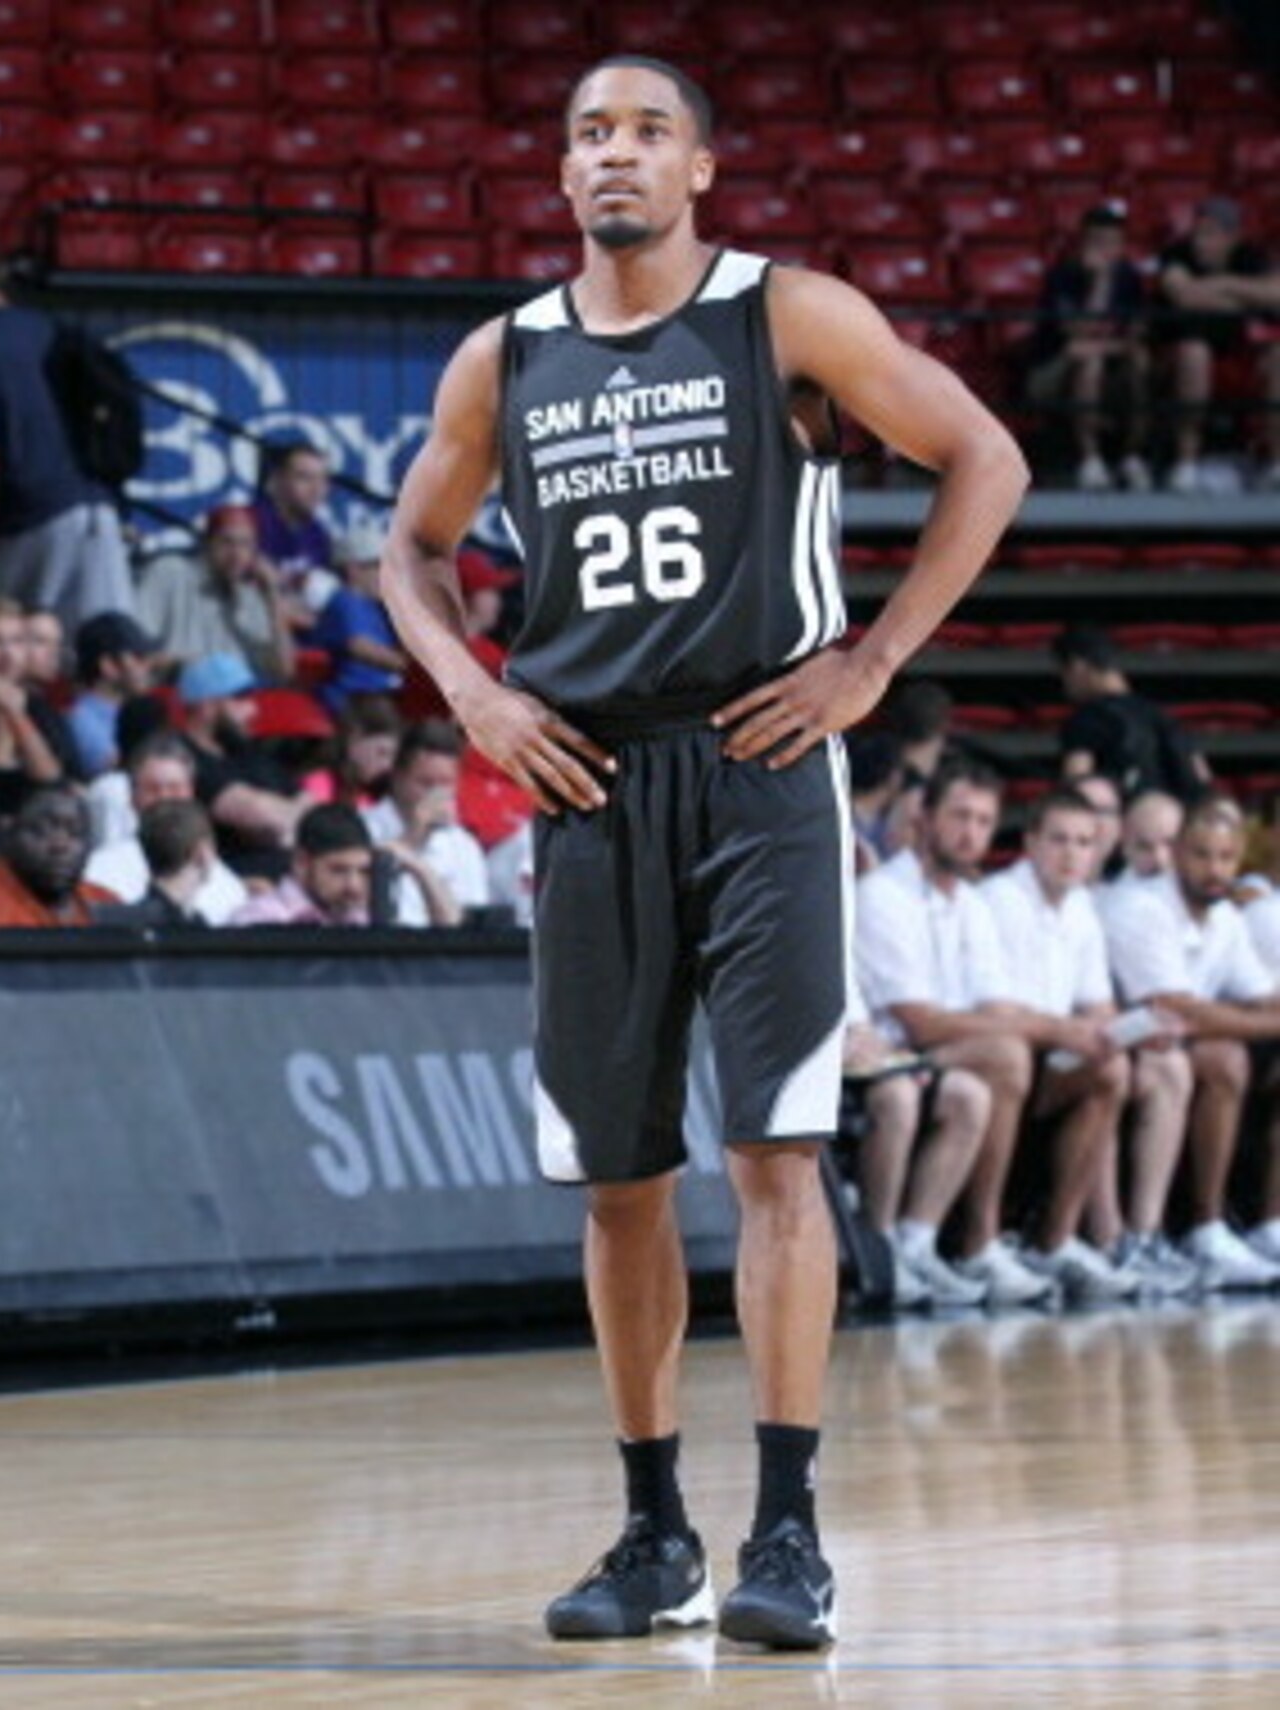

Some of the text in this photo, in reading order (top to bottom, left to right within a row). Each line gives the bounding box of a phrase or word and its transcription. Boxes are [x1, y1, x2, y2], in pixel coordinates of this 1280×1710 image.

[122, 374, 434, 502] BOY
[525, 375, 725, 441] SAN ANTONIO
[537, 446, 733, 508] BASKETBALL
[573, 506, 706, 612] 26
